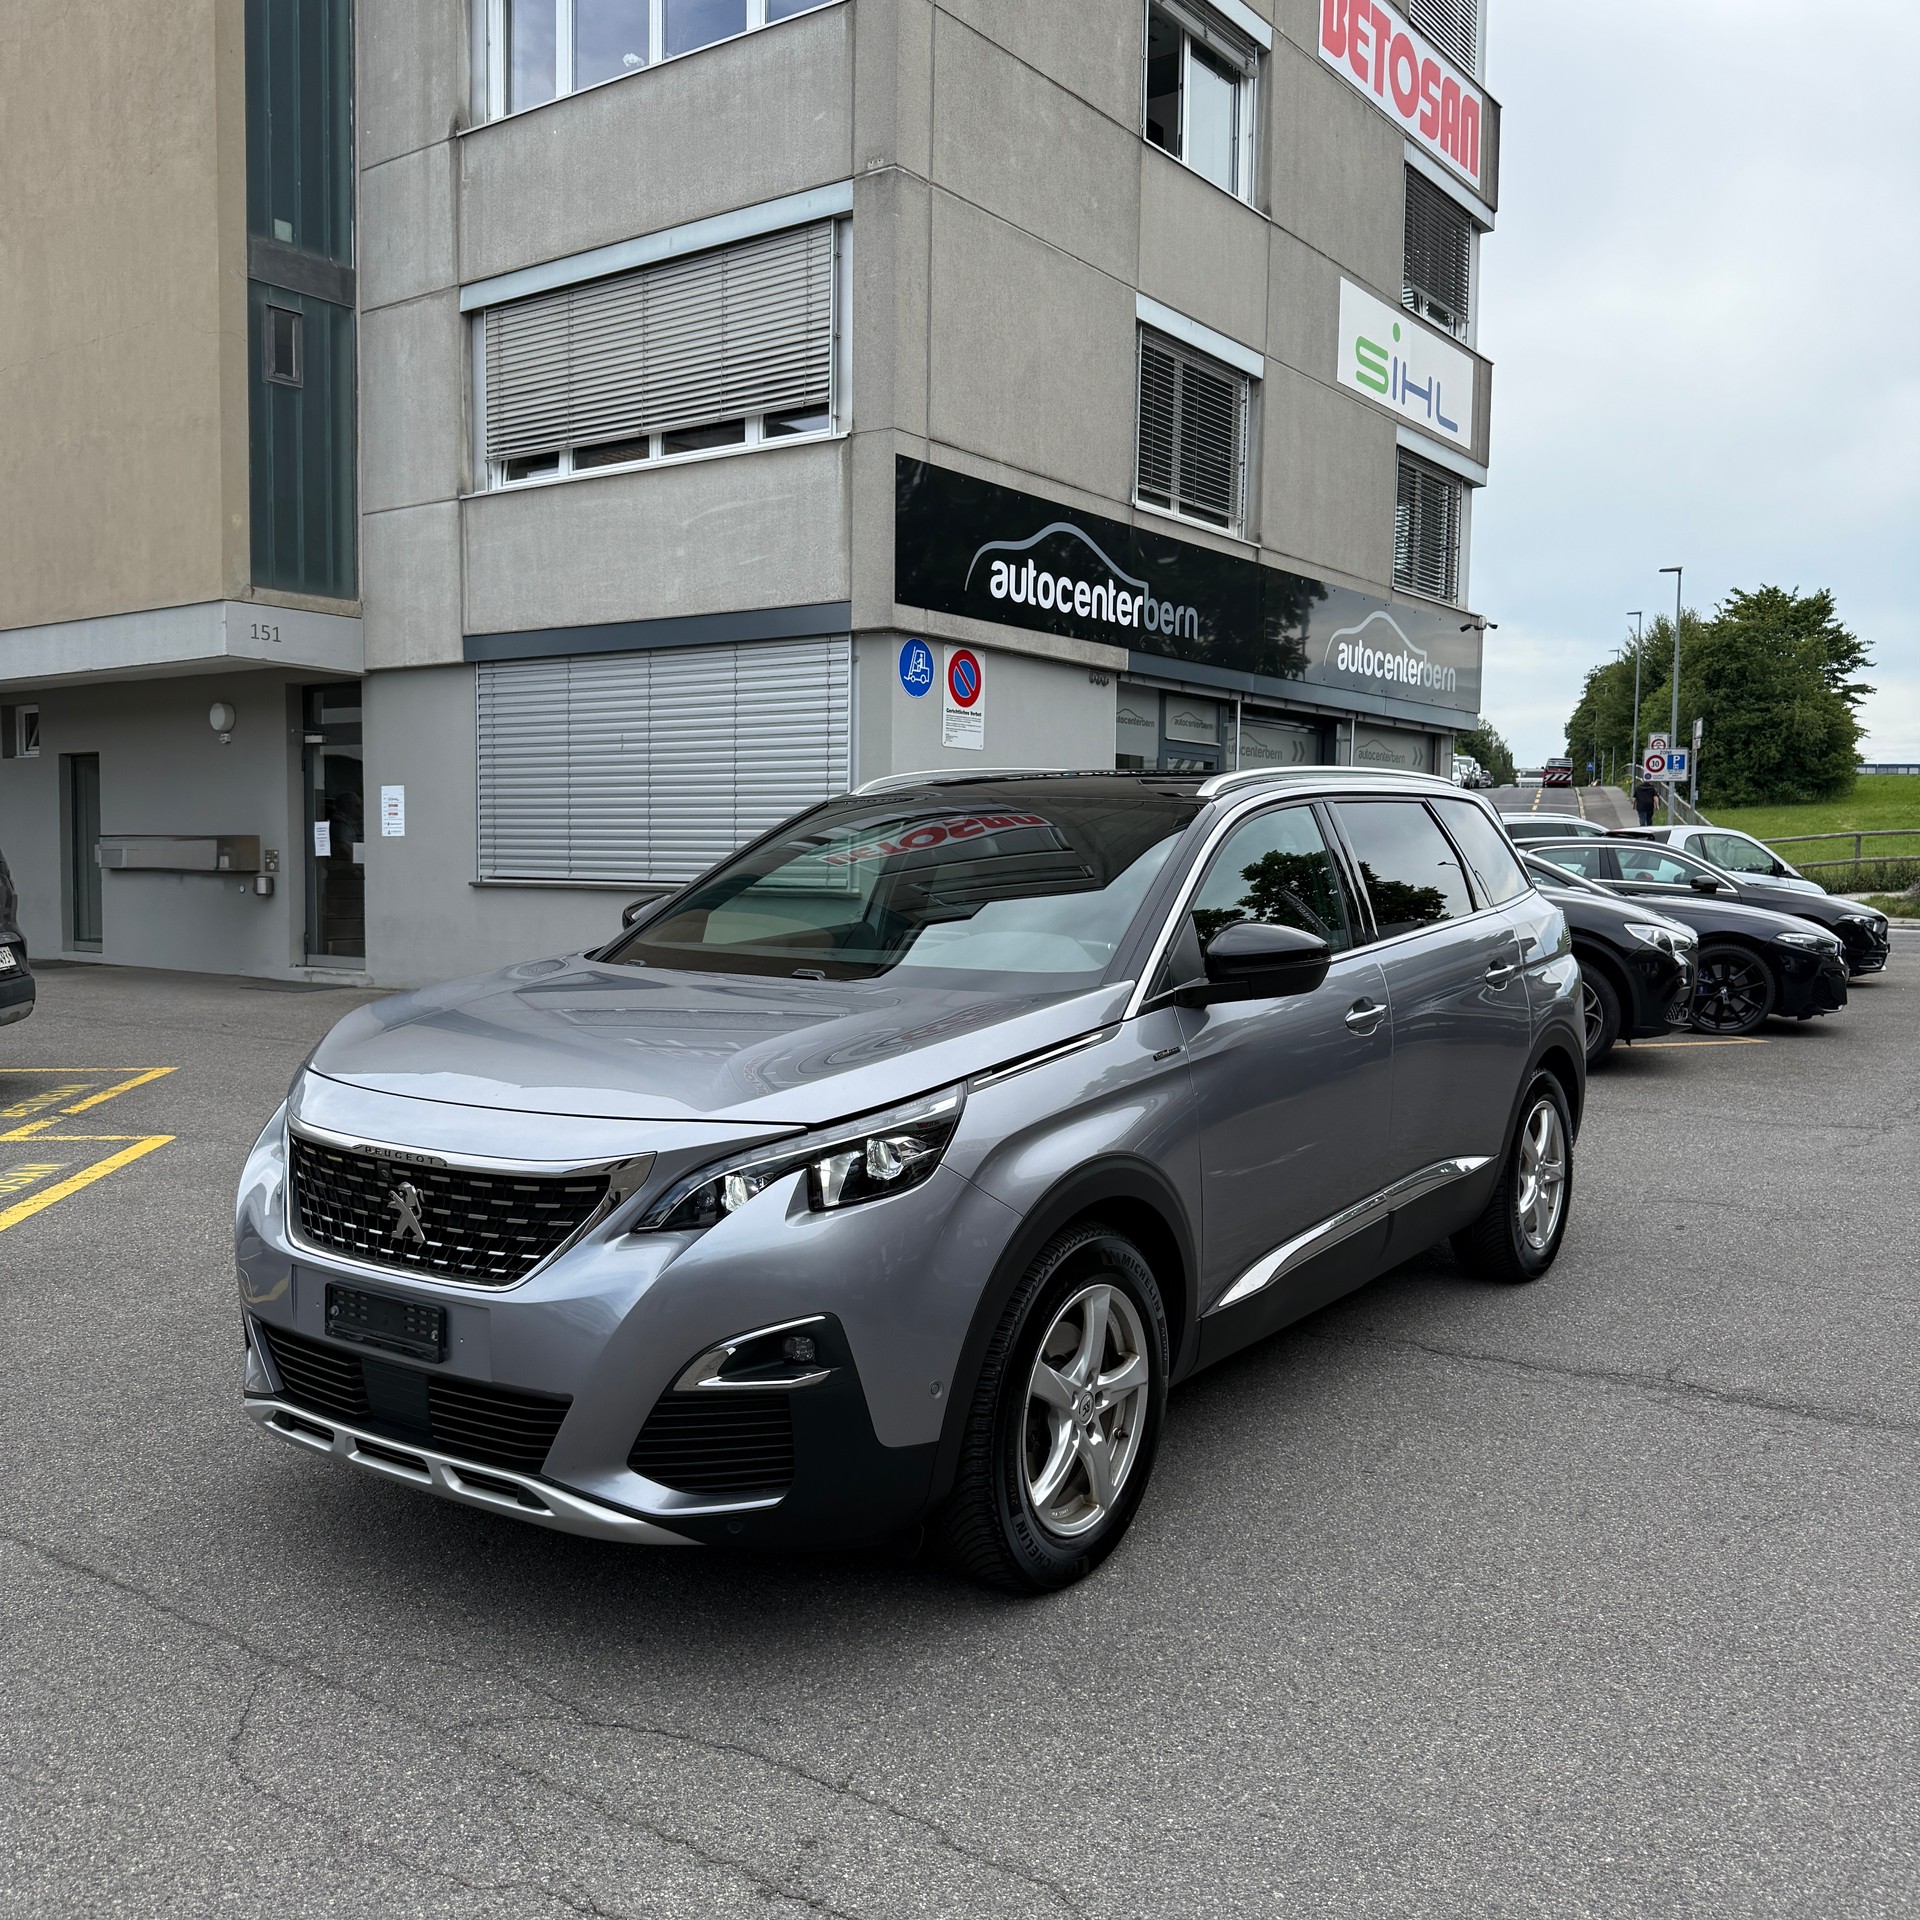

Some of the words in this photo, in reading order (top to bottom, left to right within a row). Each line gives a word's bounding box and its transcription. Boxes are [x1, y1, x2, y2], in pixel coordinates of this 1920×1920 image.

[1322, 0, 1480, 178] BETOSAN
[989, 558, 1199, 640] autocenterbern
[250, 623, 282, 643] 151
[1337, 640, 1456, 693] autocenterbern
[1173, 717, 1214, 730] autocenterbern
[1358, 748, 1406, 764] autocenterbern
[1651, 760, 1660, 768] 30
[1673, 755, 1681, 764] P
[365, 1146, 435, 1165] PEUGEOT
[1121, 1253, 1162, 1314] MICHELIN
